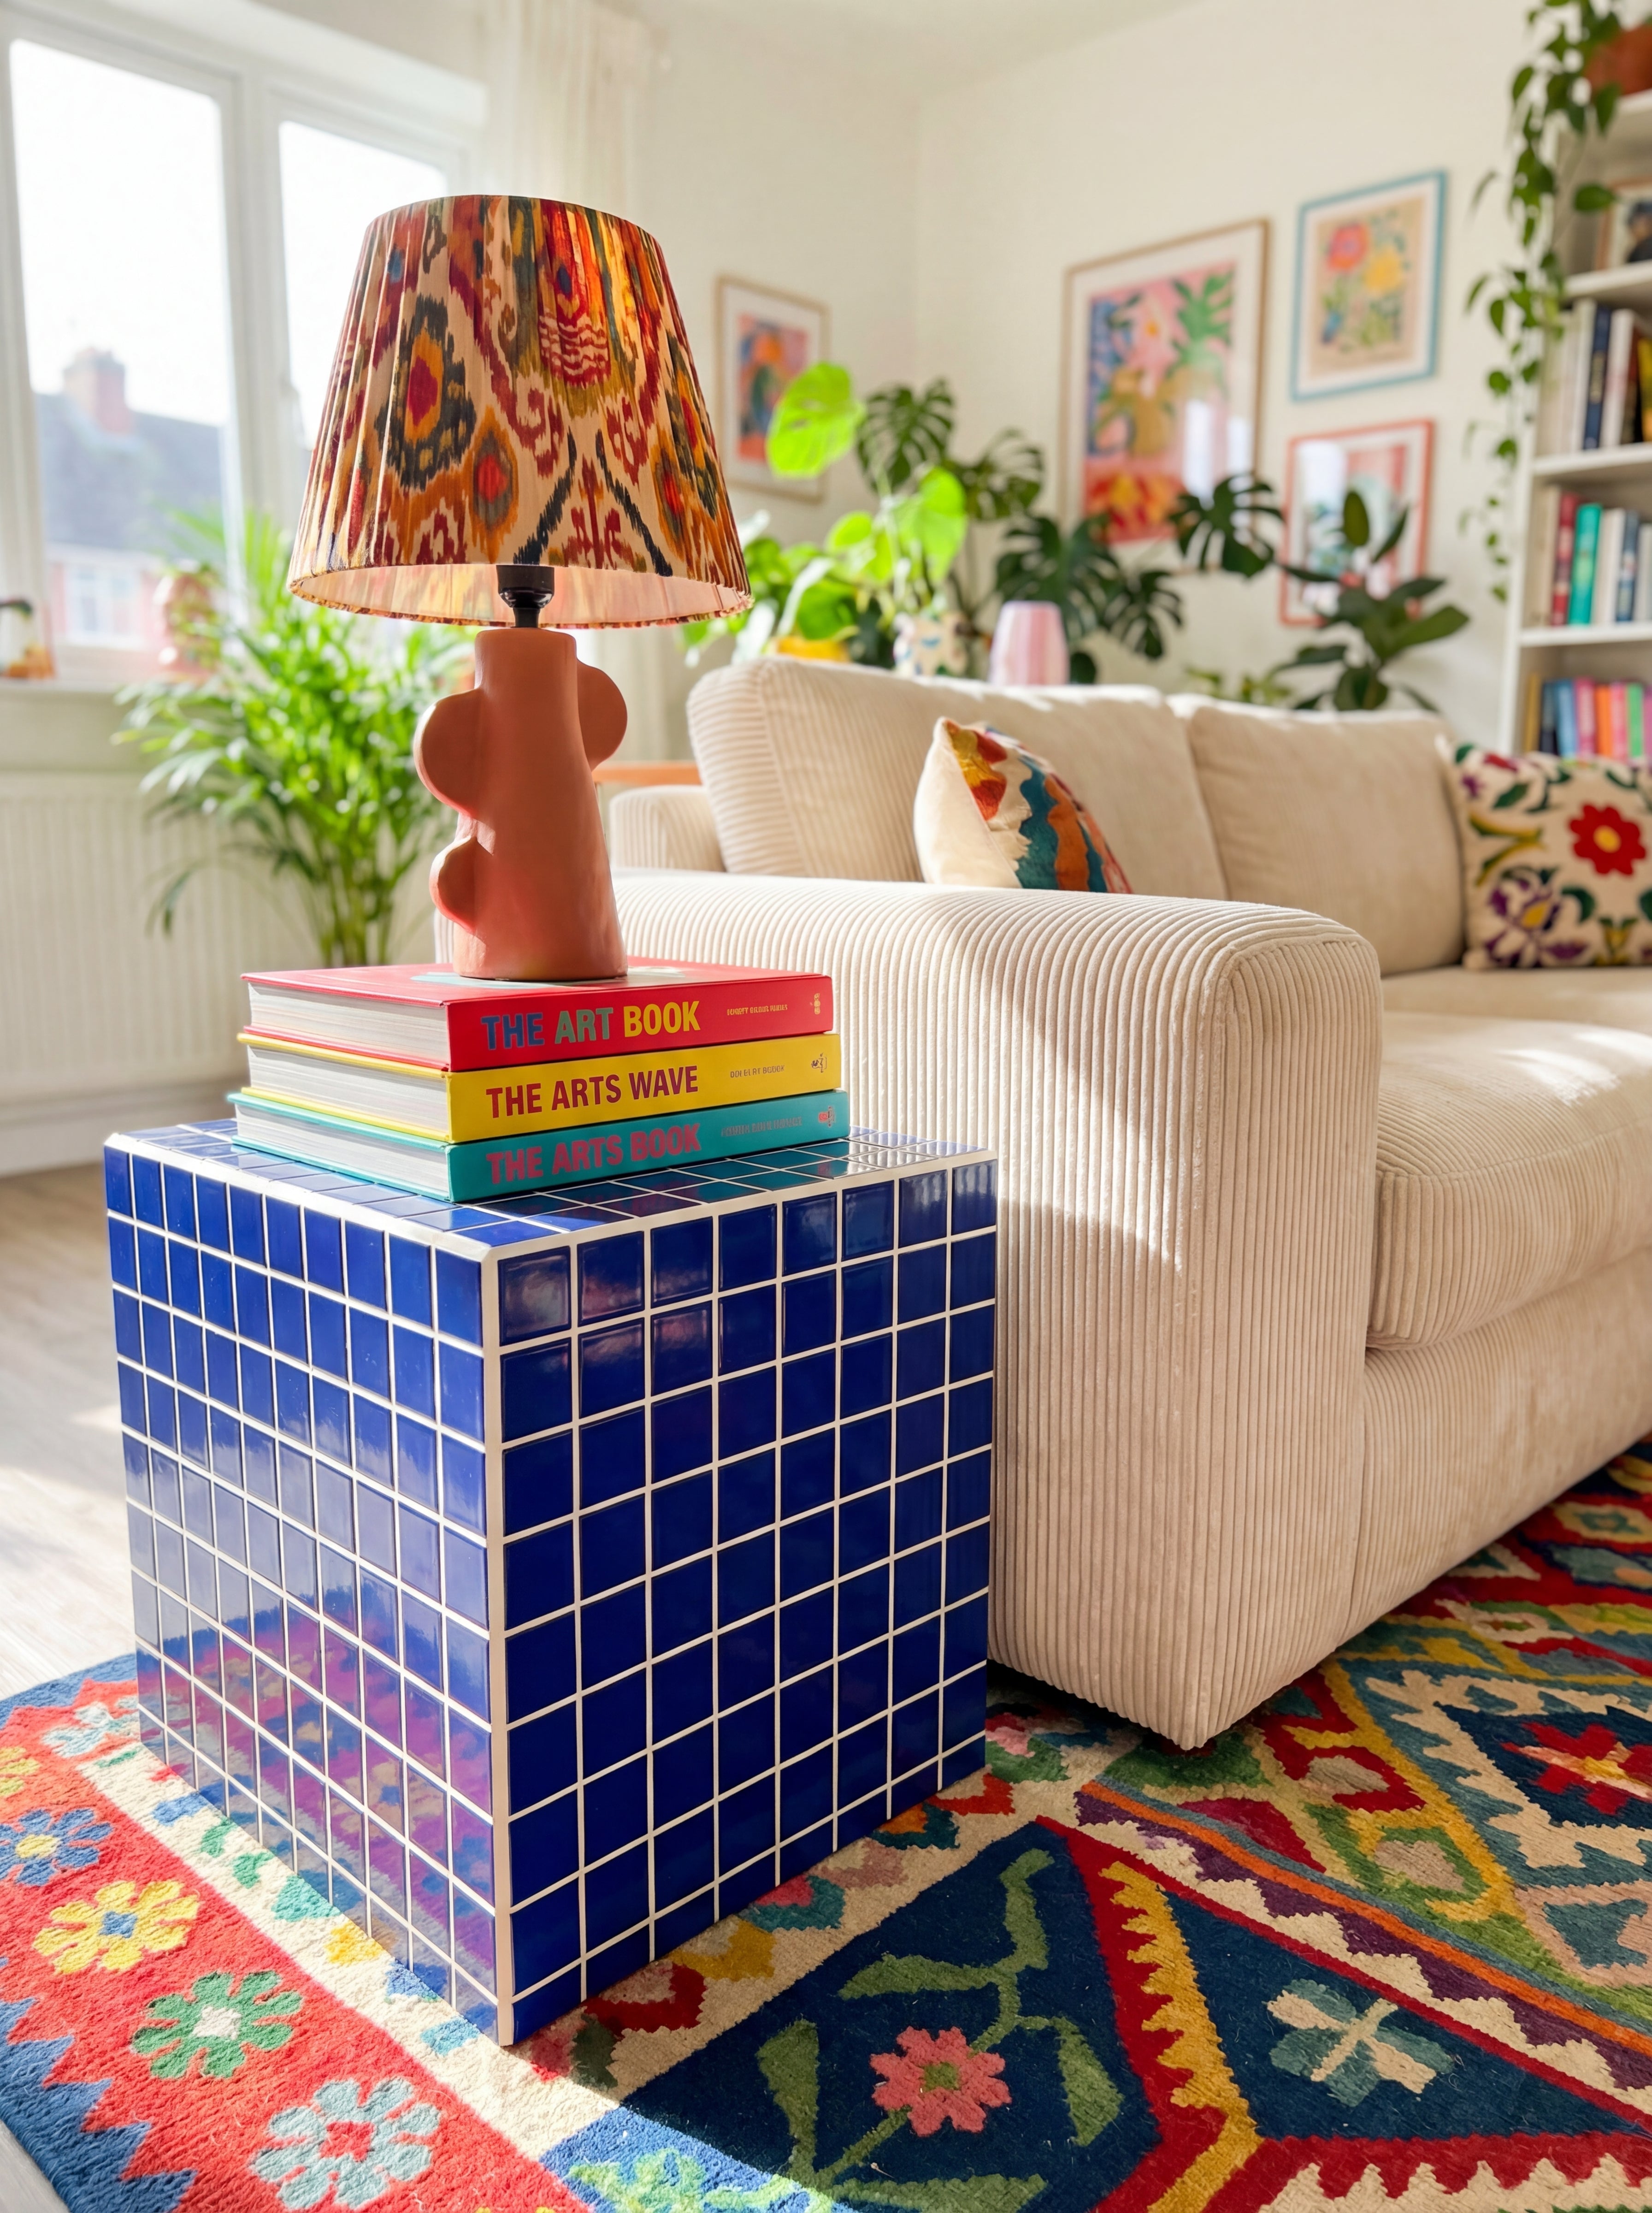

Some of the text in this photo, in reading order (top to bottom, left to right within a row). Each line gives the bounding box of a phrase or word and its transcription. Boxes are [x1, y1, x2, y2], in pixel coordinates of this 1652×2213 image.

[481, 1000, 701, 1050] THE ART BOOK
[486, 1065, 698, 1118] THE ARTS WAVE
[486, 1146, 543, 1184] THE
[552, 1135, 623, 1175] ARTS
[631, 1123, 701, 1161] BOOK
